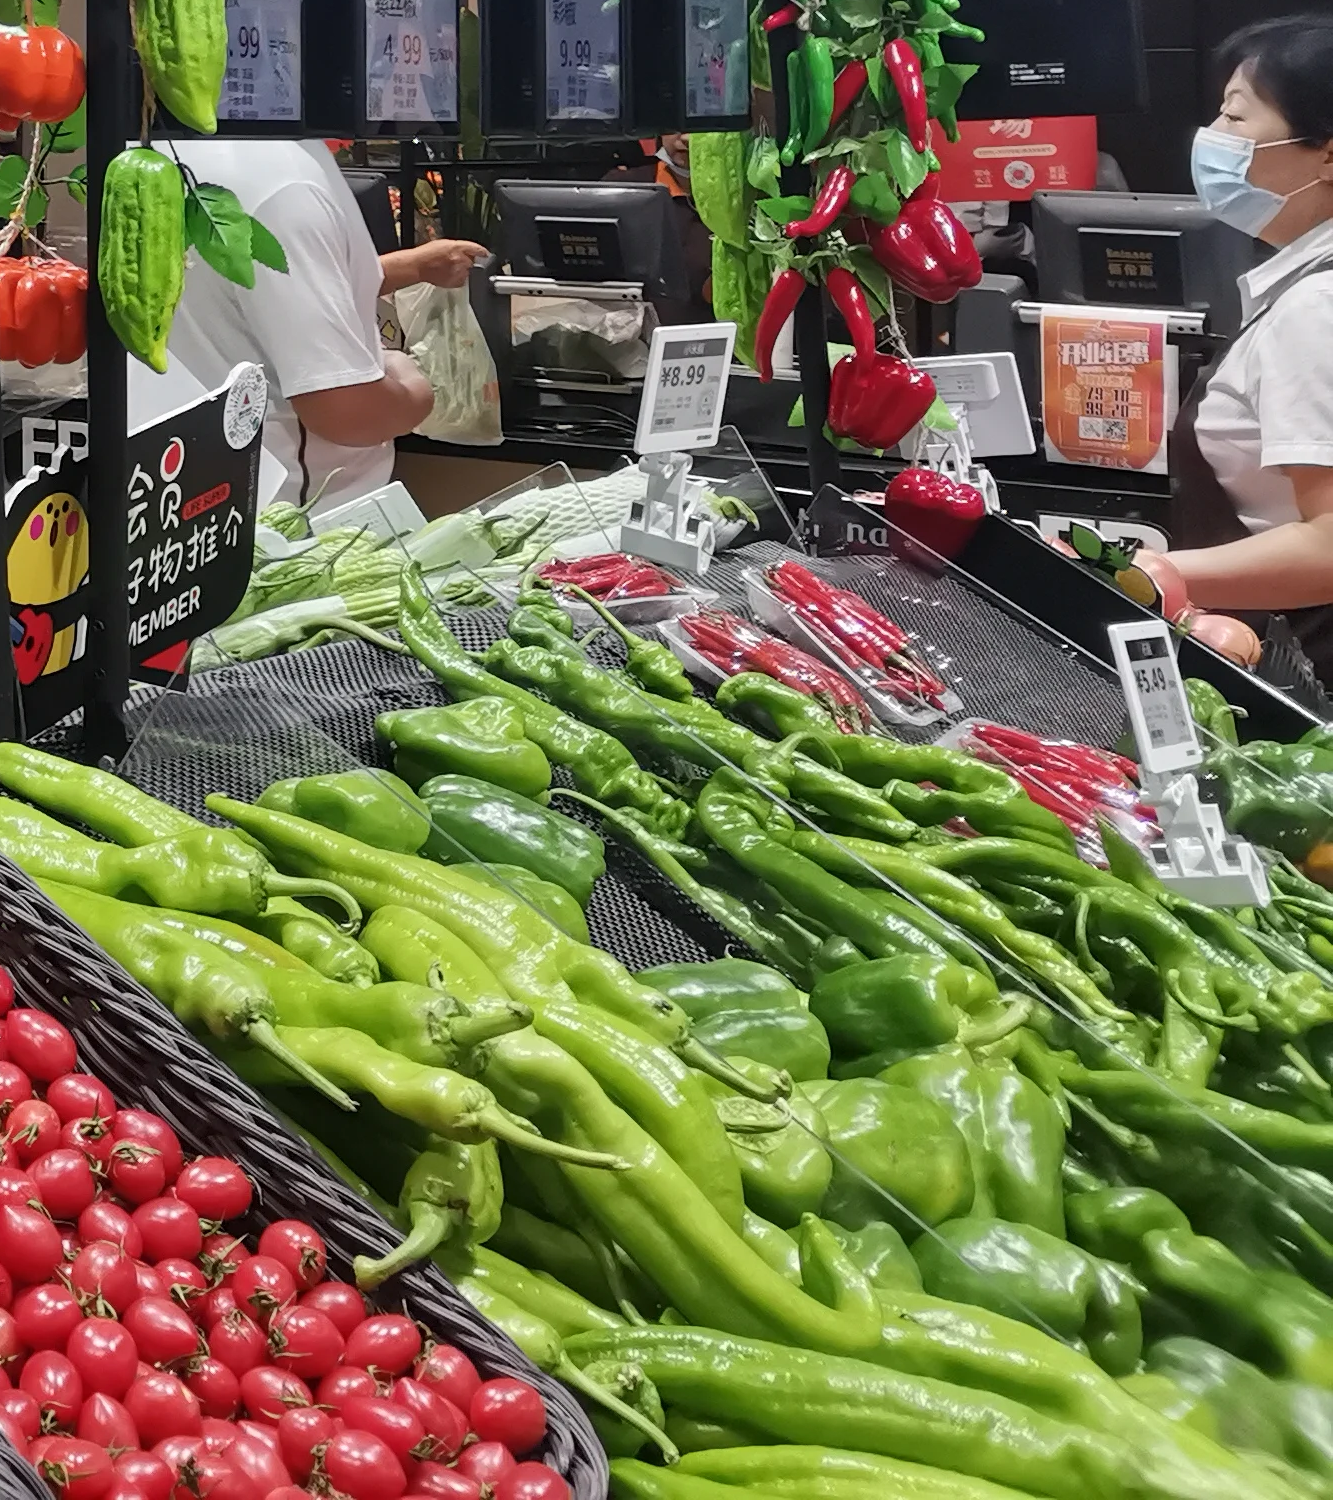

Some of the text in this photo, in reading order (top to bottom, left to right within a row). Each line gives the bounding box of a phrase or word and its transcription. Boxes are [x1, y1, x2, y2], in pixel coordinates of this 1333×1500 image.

[228, 26, 260, 58] .99
[383, 34, 422, 65] 4.99
[560, 40, 592, 67] 9.99
[661, 364, 706, 388] ¥8.99
